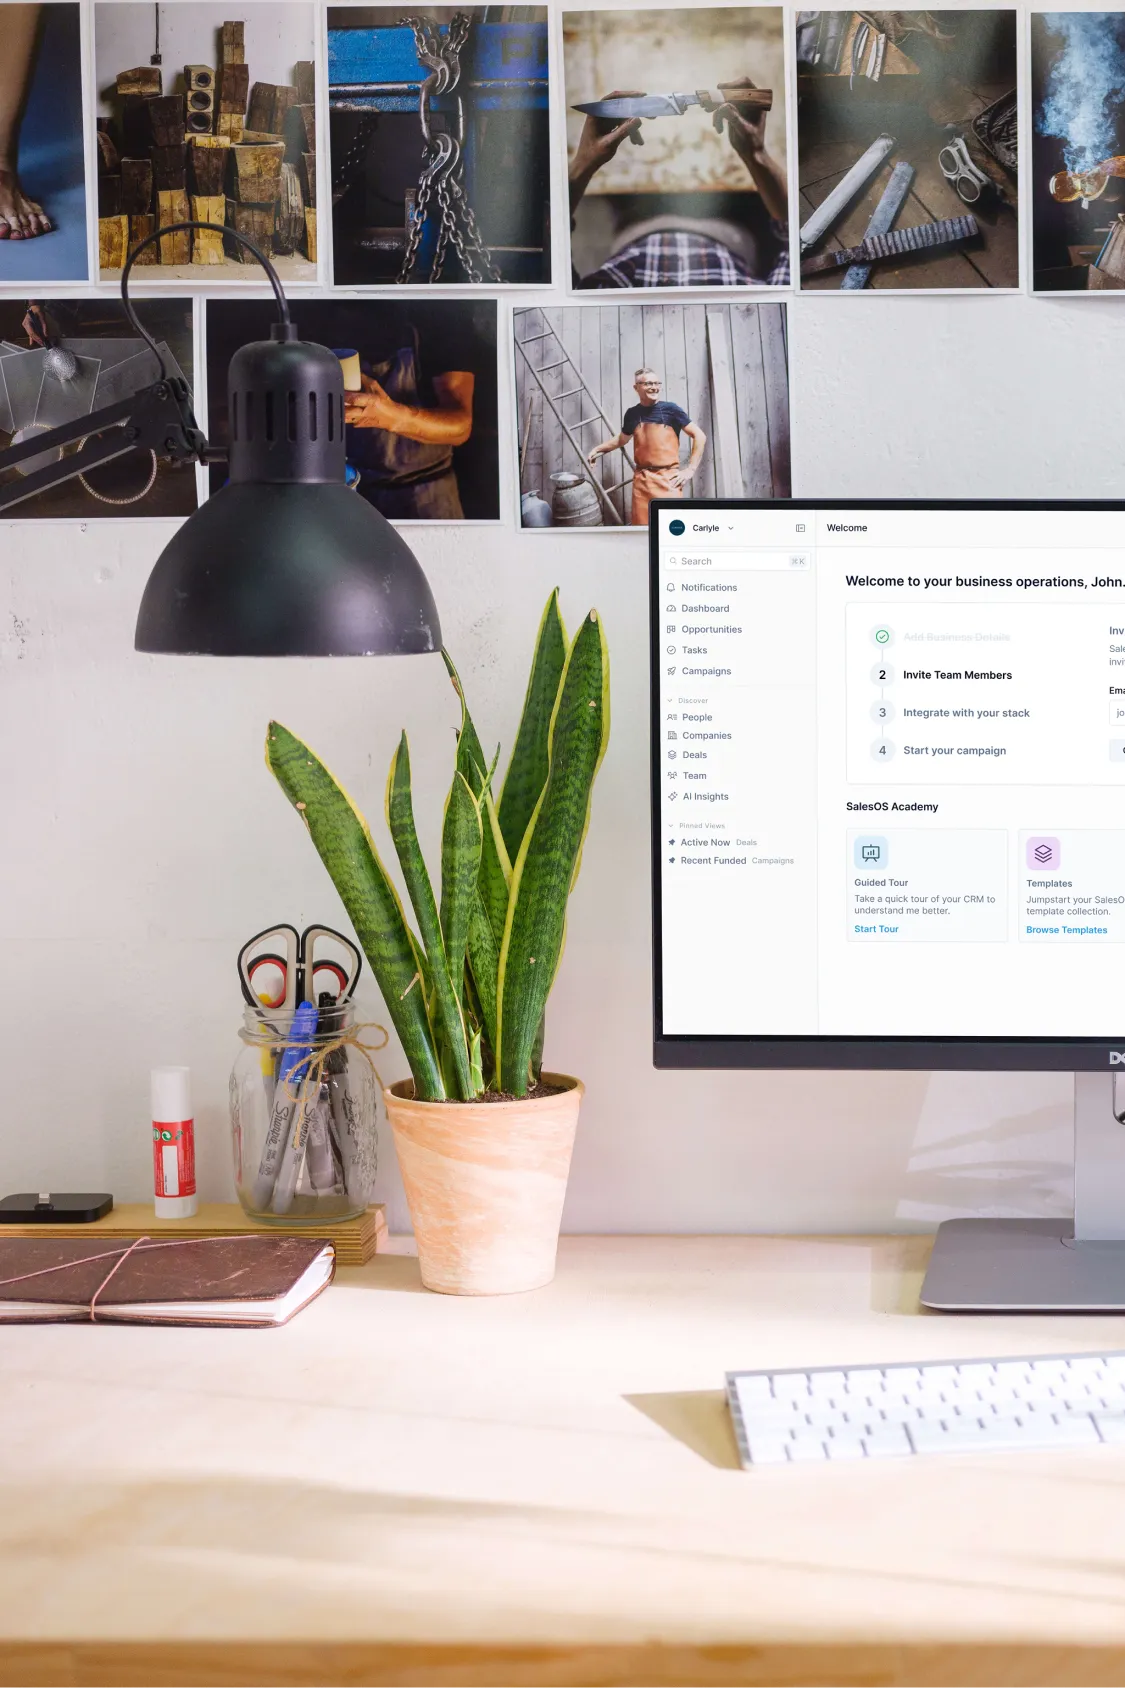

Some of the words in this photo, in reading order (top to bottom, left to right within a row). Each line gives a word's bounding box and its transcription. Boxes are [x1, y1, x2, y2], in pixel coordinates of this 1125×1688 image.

[692, 524, 720, 533] Carlyle
[826, 523, 868, 532] Welcome
[681, 557, 712, 566] Search
[681, 583, 738, 592] Notifications
[845, 575, 905, 587] Welcome
[907, 576, 921, 587] to
[923, 578, 953, 589] your
[955, 575, 1013, 587] business
[1016, 576, 1088, 590] operations,
[1091, 576, 1125, 588] John.
[681, 604, 730, 613] Dashboard
[681, 625, 743, 635] Opportunities
[682, 646, 708, 654] Tasks
[681, 666, 732, 677] Campaigns
[879, 669, 886, 680] 2
[903, 670, 932, 680] Invite
[934, 670, 962, 680] Team
[964, 670, 1013, 680] Members
[879, 707, 887, 718] 3
[903, 708, 950, 720] Integrate
[952, 708, 975, 717] with
[976, 710, 1000, 720] your
[1002, 708, 1030, 718] stack
[682, 713, 713, 723] People
[682, 731, 732, 741] Companies
[682, 750, 708, 759] Deals
[879, 745, 887, 755] 4
[903, 745, 929, 755] Start
[931, 747, 955, 757] your
[956, 745, 1007, 758] campaign
[683, 771, 707, 780] Team
[683, 792, 692, 800] AI
[694, 792, 729, 803] Insights
[846, 801, 889, 811] SalesOS
[891, 802, 939, 814] Academy
[680, 838, 709, 847] Active
[710, 838, 731, 847] Now
[736, 838, 758, 846] Deals
[681, 856, 712, 865] Recent
[713, 856, 747, 865] Funded
[751, 857, 795, 866] Campaigns
[854, 878, 886, 887] Guided
[888, 878, 909, 887] Tour
[1026, 879, 1073, 889] Templates
[854, 894, 875, 903] Take
[884, 894, 909, 905] quick
[930, 894, 940, 903] of
[941, 896, 961, 905] your
[963, 895, 984, 904] CRM
[986, 896, 996, 904] to
[1026, 895, 1071, 905] Jumpstart
[1072, 897, 1093, 906] your
[854, 906, 904, 915] understand
[922, 906, 951, 915] better.
[1026, 907, 1065, 917] template
[1066, 907, 1111, 916] collection.
[854, 924, 877, 933] Start
[878, 925, 899, 933] Tour
[1026, 925, 1060, 934] Browse
[1061, 925, 1108, 936] Templates
